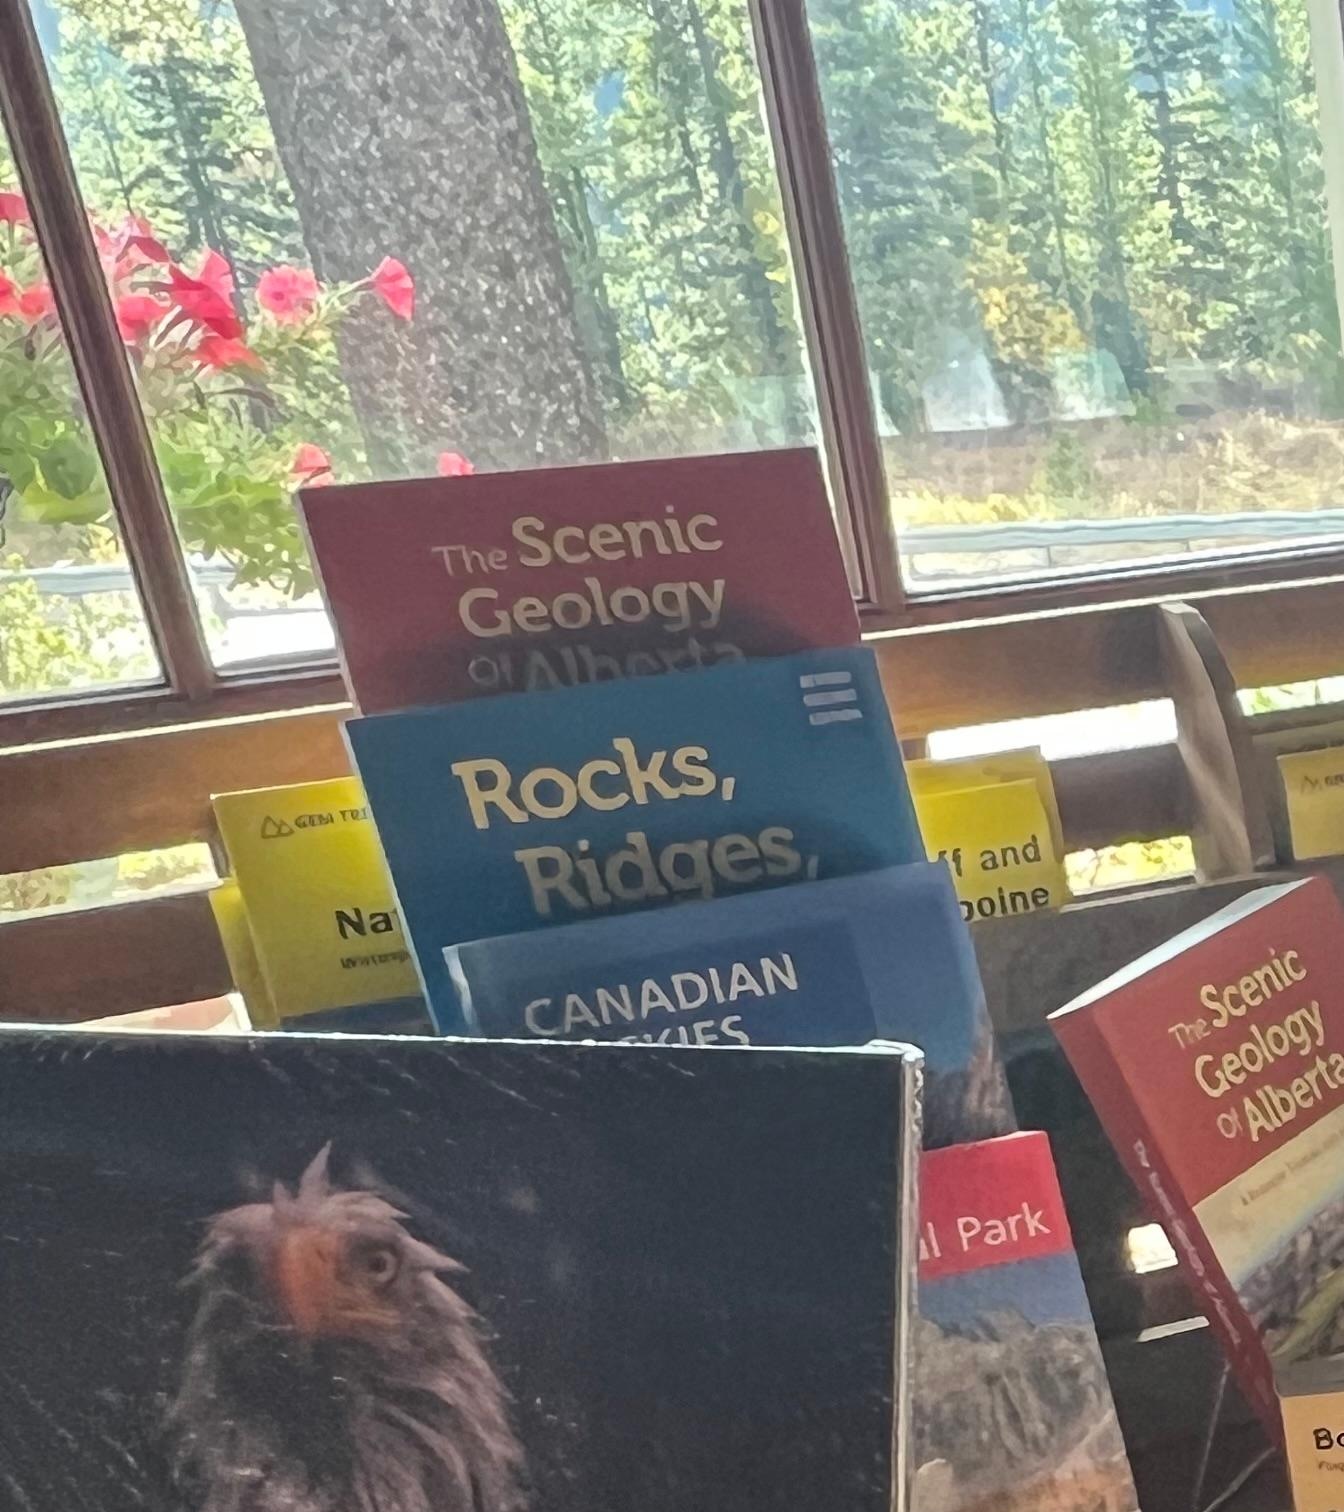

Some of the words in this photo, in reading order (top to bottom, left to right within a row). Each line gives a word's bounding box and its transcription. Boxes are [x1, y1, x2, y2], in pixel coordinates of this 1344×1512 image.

[431, 544, 508, 577] The
[512, 504, 724, 567] Scenic
[458, 577, 726, 637] Geology
[451, 737, 736, 829] Rocks,
[514, 826, 819, 917] Ridges,
[980, 834, 1042, 871] and
[524, 953, 800, 1037] CANADIAN
[1168, 1018, 1211, 1049] The
[1200, 947, 1307, 1028] Scenic
[1195, 1000, 1325, 1098] Geology
[957, 1202, 1051, 1252] Park
